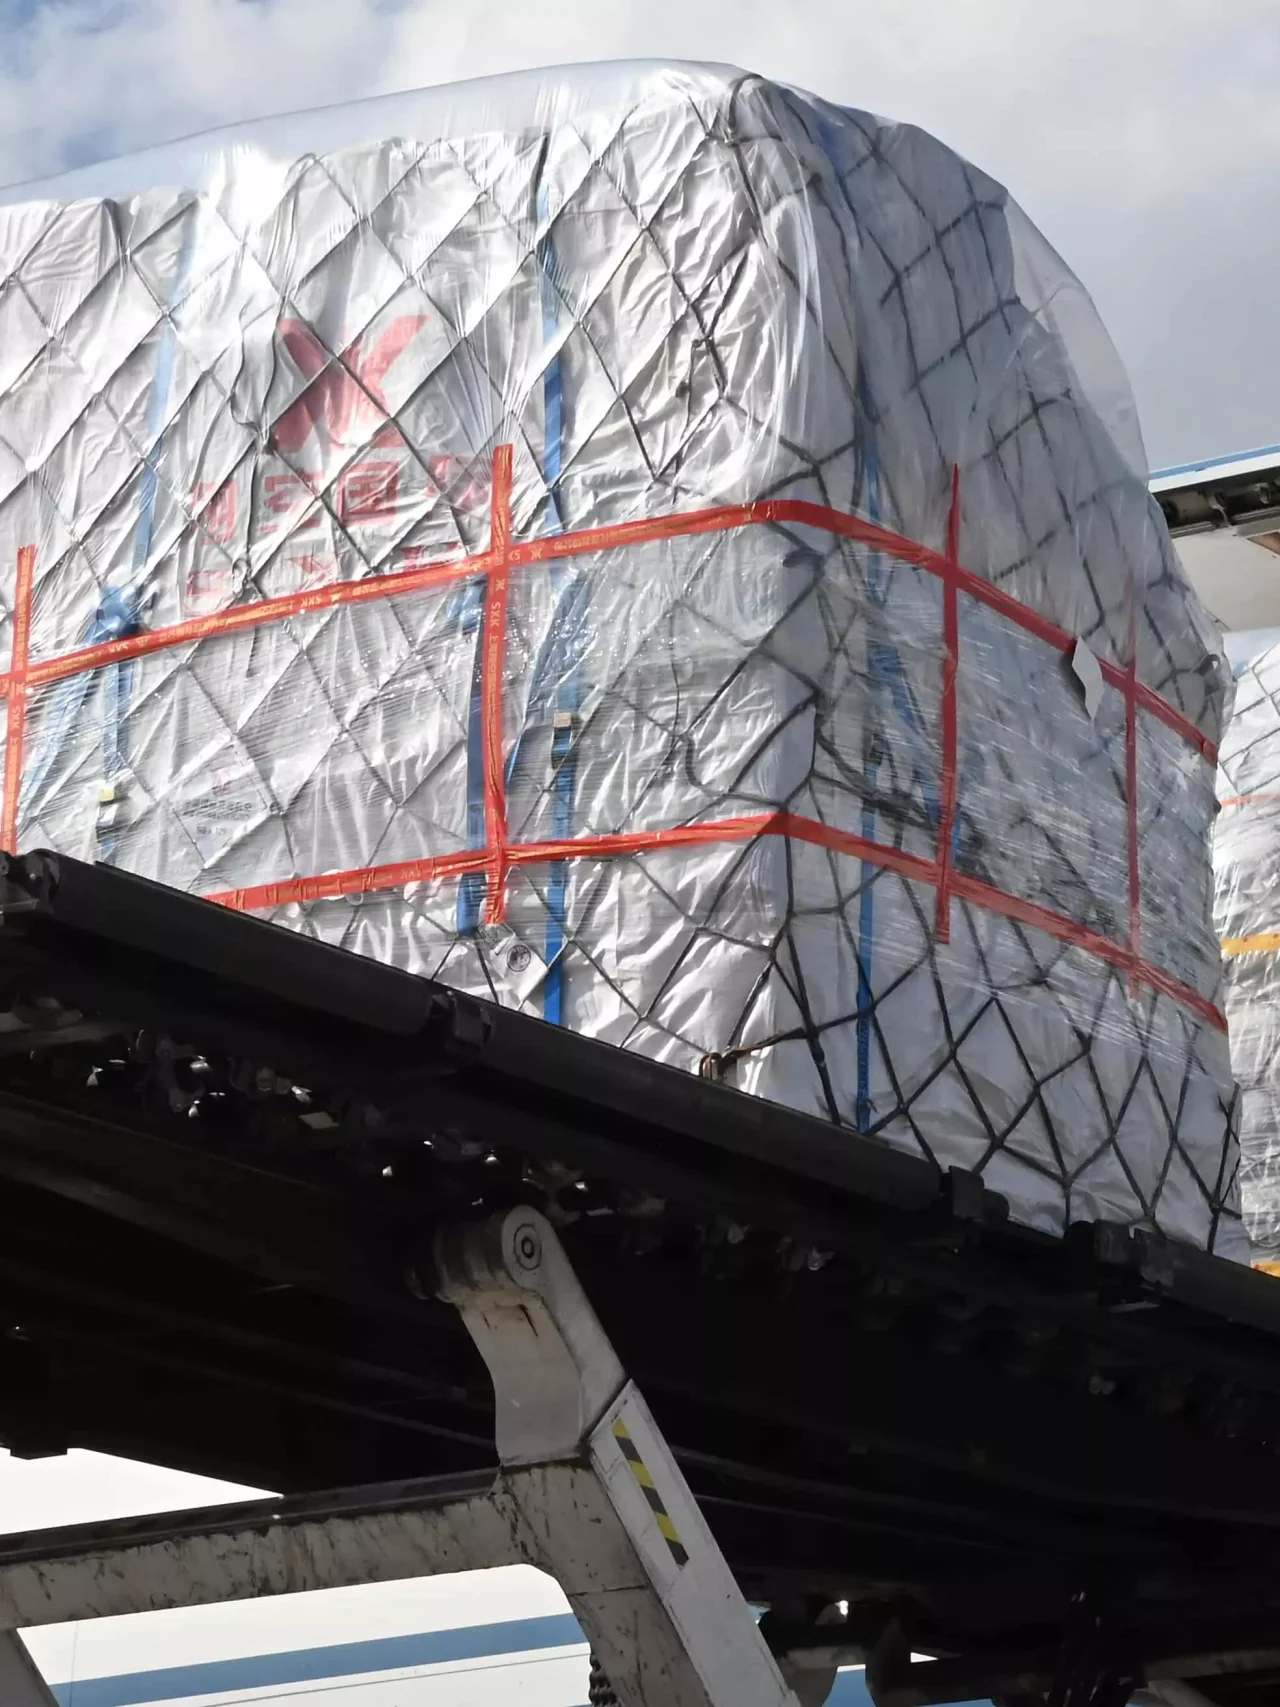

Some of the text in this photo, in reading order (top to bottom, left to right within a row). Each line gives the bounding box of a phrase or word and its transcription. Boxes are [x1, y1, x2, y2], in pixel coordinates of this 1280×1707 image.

[301, 595, 322, 608] SXK
[490, 601, 502, 627] SXK
[9, 708, 22, 730] SXK
